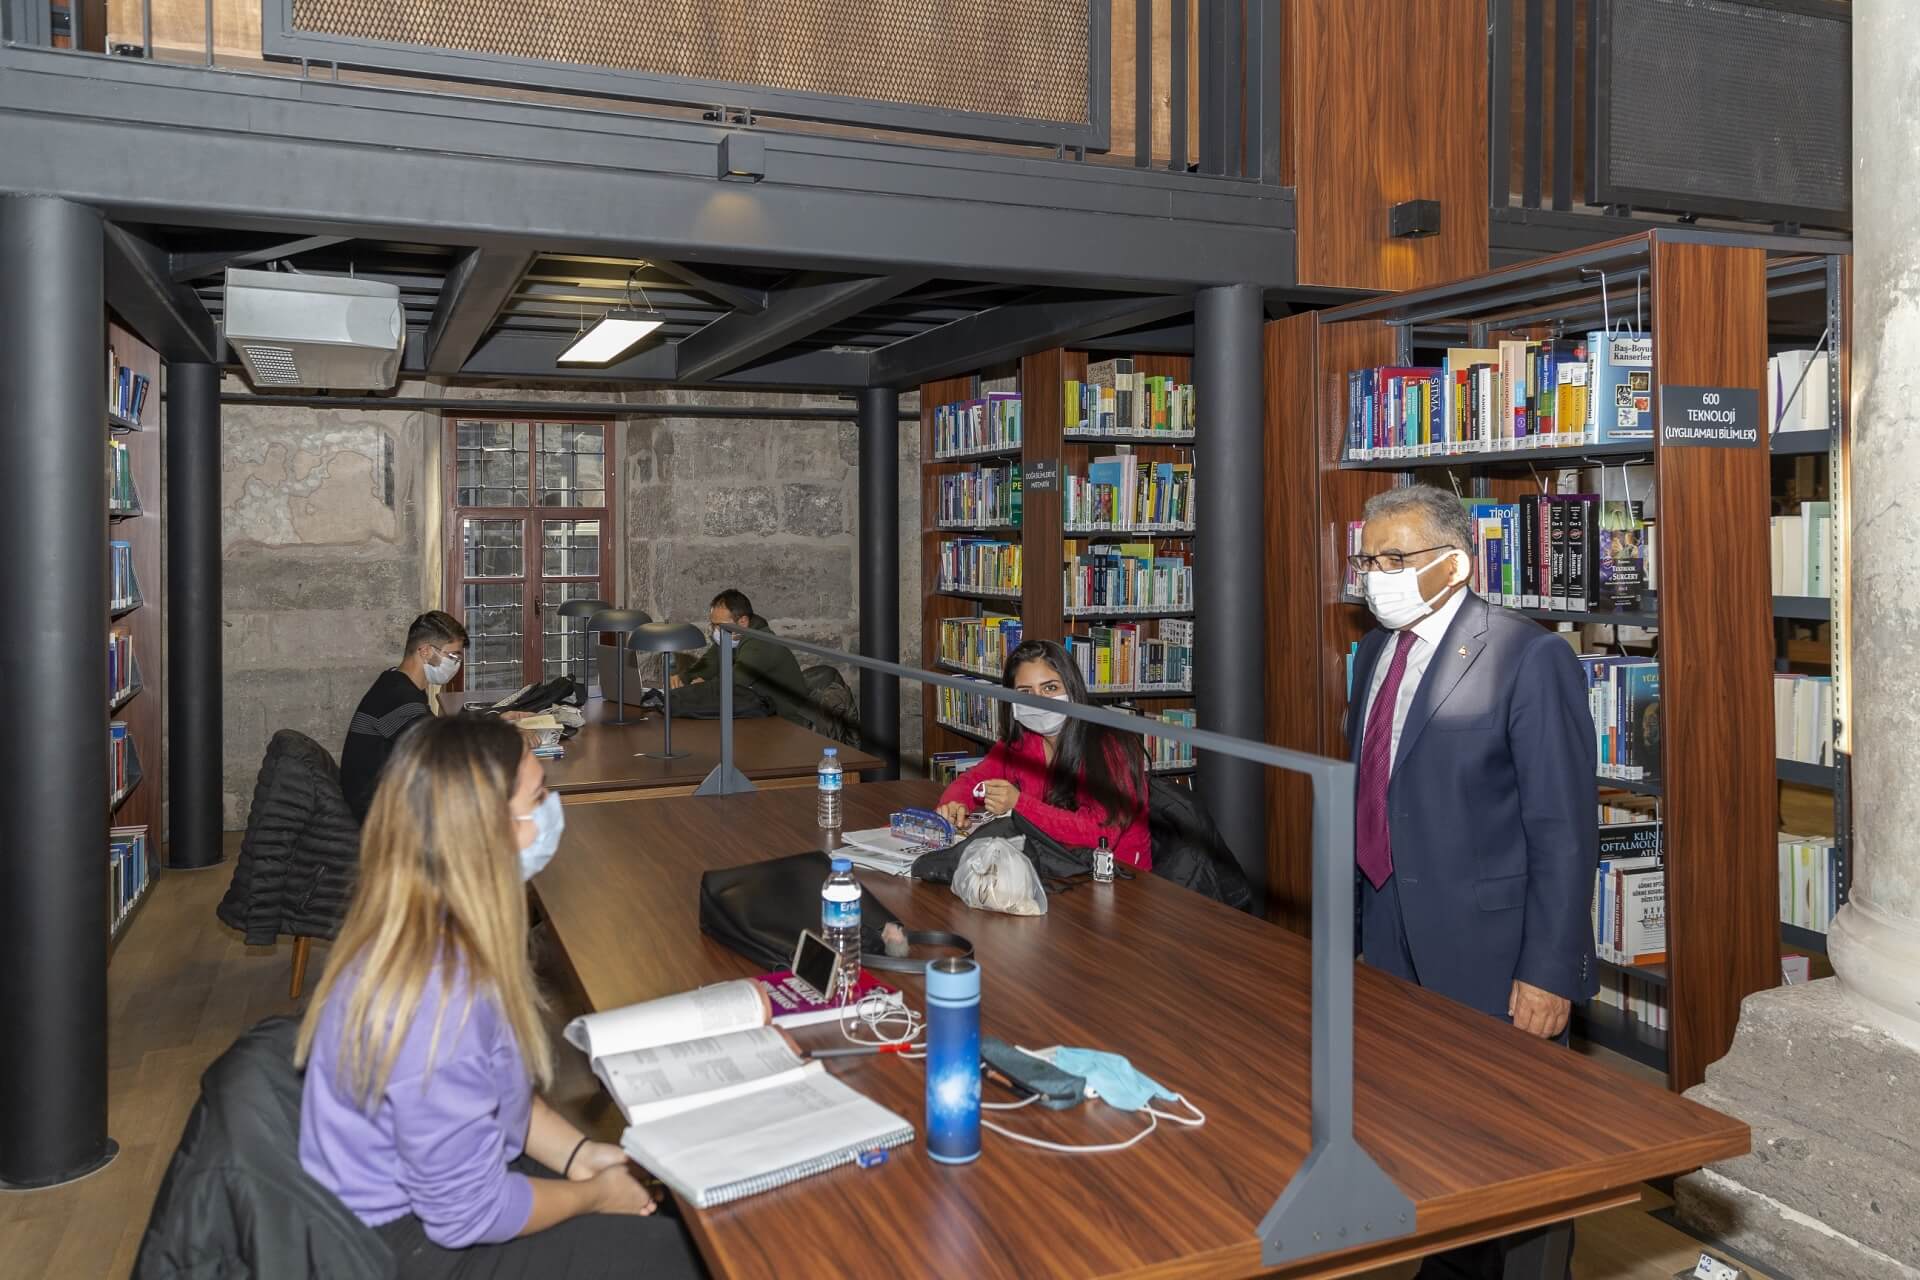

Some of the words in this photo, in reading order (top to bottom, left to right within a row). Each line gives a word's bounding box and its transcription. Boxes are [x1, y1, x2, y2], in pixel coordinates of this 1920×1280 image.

[1430, 377, 1439, 412] SITMA
[1702, 393, 1720, 405] 600
[1665, 426, 1718, 440] (UYGULAMALI
[1718, 427, 1757, 442] BİLİMLER)
[1489, 507, 1513, 519] TİROİ
[1601, 840, 1663, 851] OFTALMOLOİ
